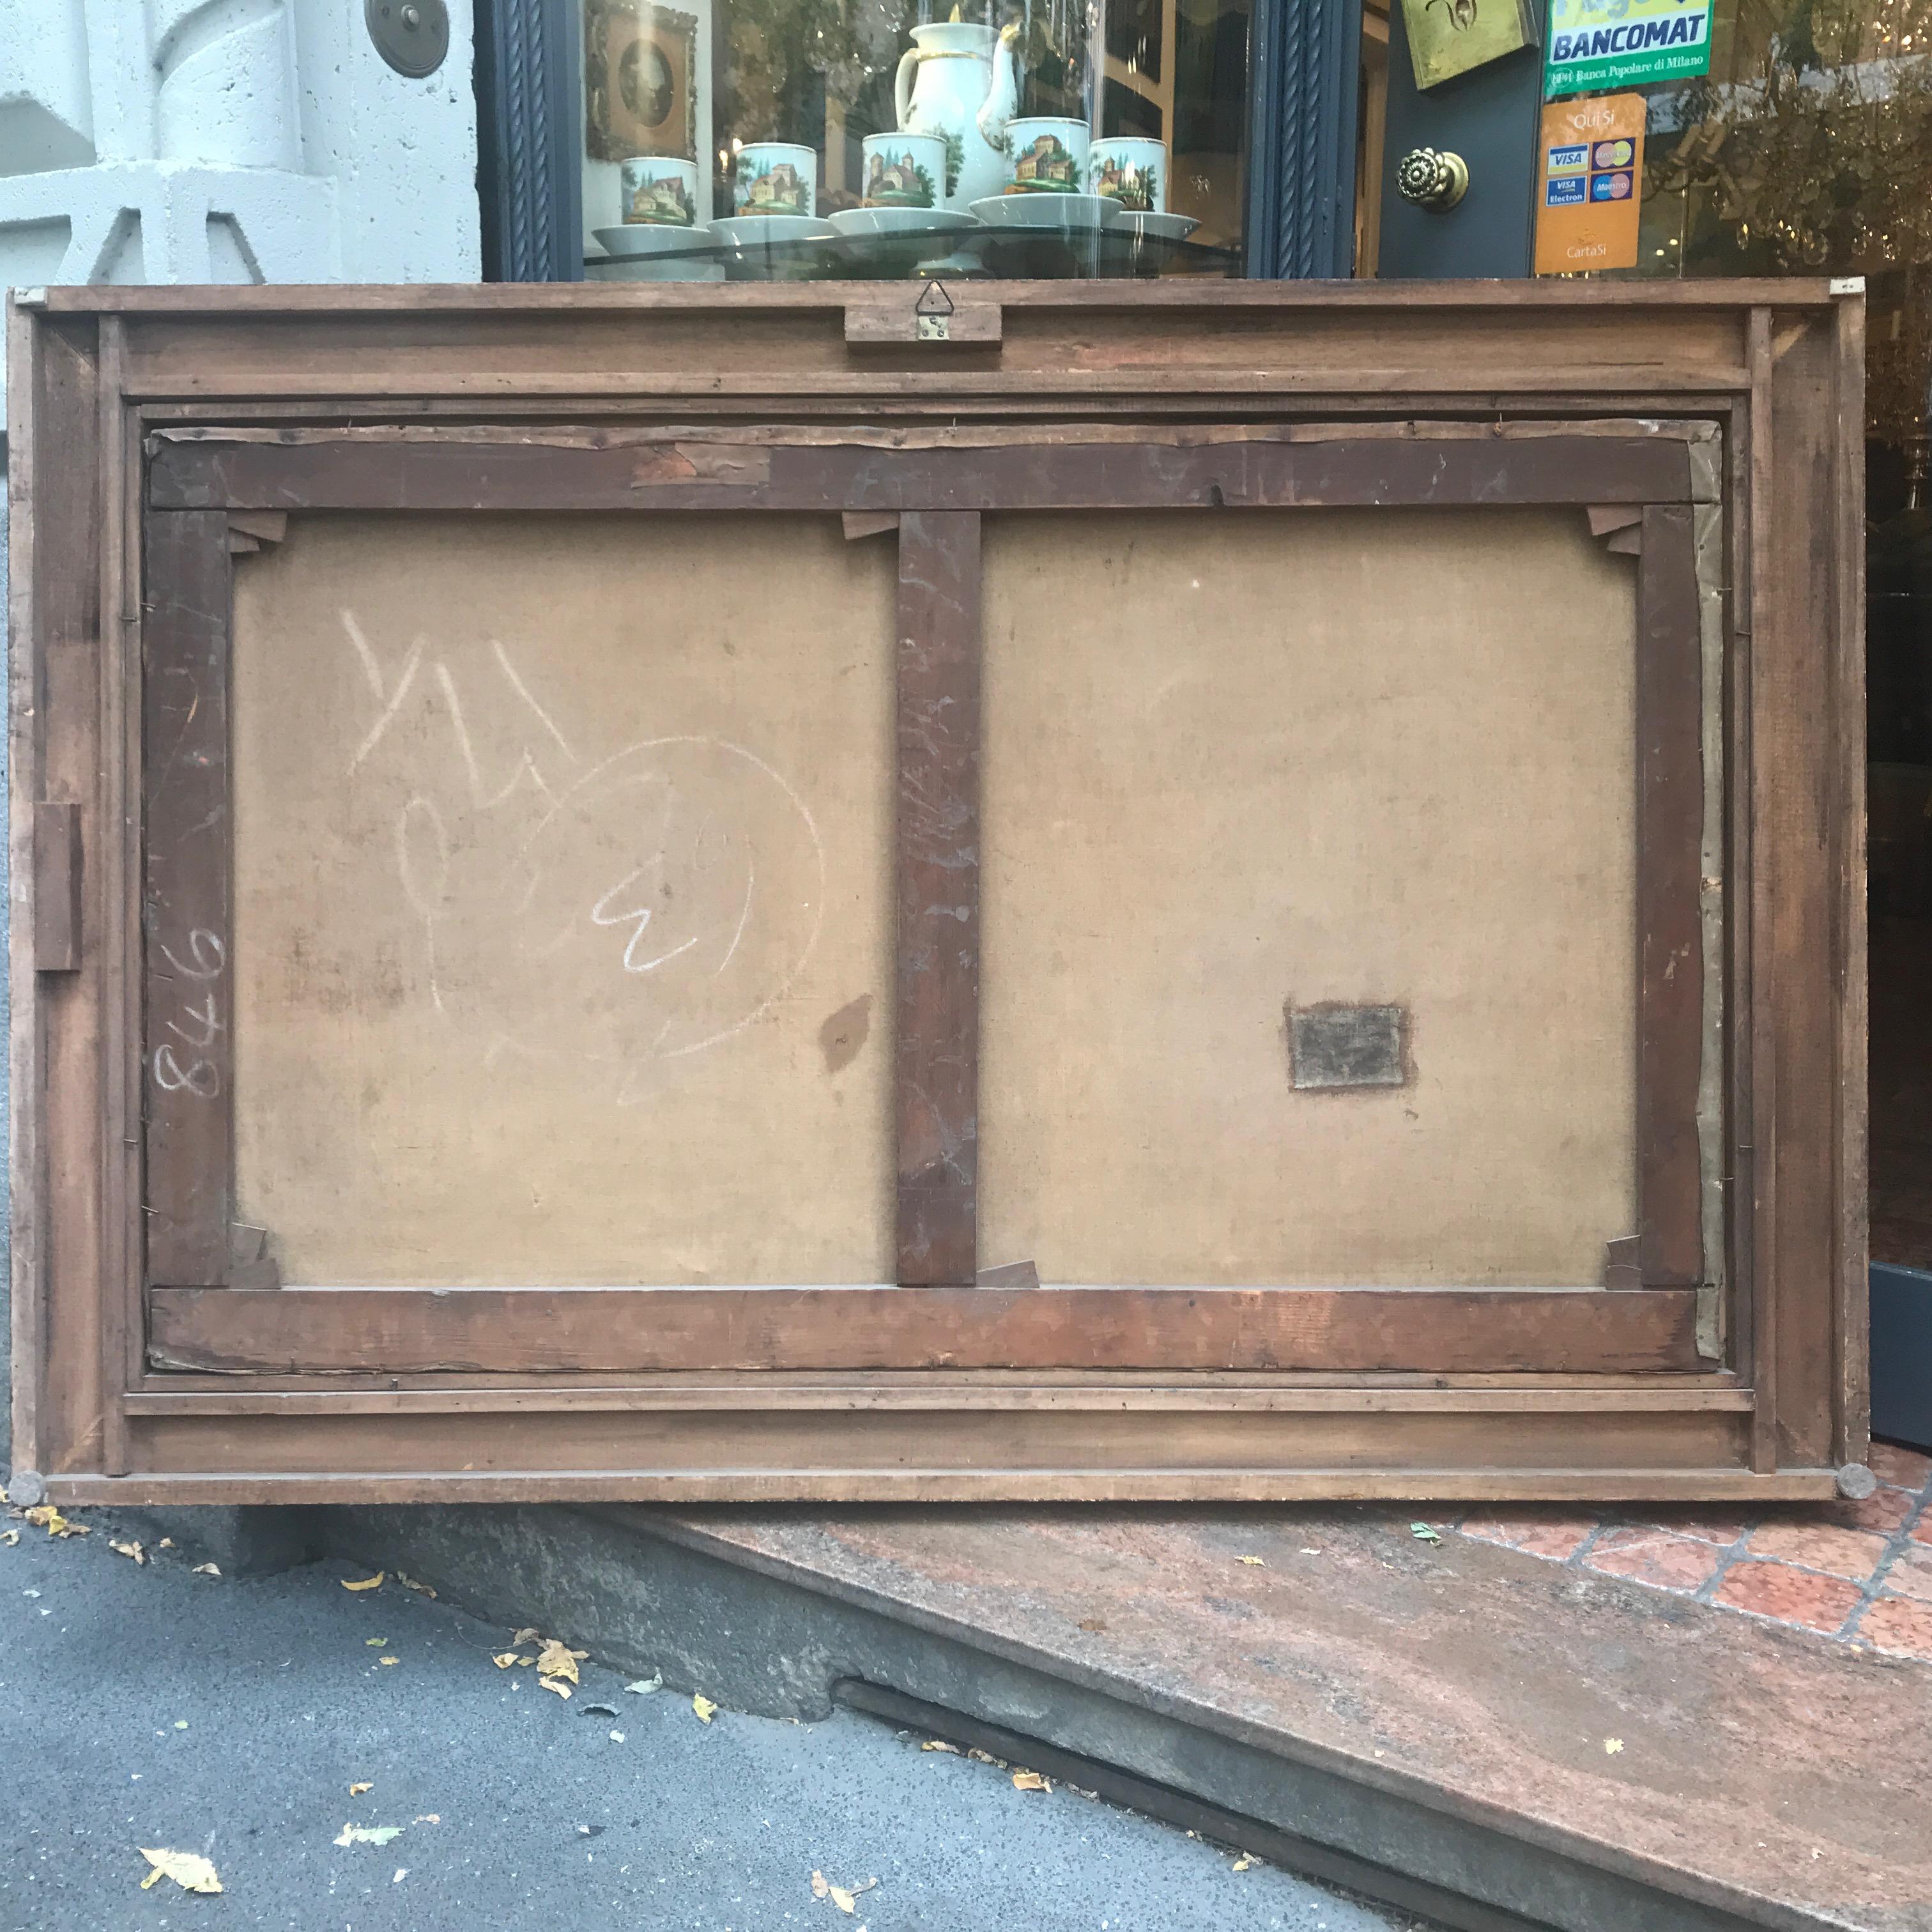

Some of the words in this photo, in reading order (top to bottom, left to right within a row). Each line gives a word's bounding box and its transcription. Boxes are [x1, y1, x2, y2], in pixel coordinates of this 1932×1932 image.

[1553, 13, 1706, 61] BANCOMAT
[1576, 69, 1606, 82] Banca
[1608, 63, 1652, 79] Popolare
[1654, 58, 1665, 70] di
[1667, 56, 1704, 69] Milano
[1574, 112, 1600, 130] Qui
[1555, 153, 1582, 165] VISA
[1557, 180, 1575, 190] VISA
[1597, 182, 1627, 192] Maestro
[1550, 194, 1583, 203] Electron
[1567, 243, 1607, 258] CartaSi
